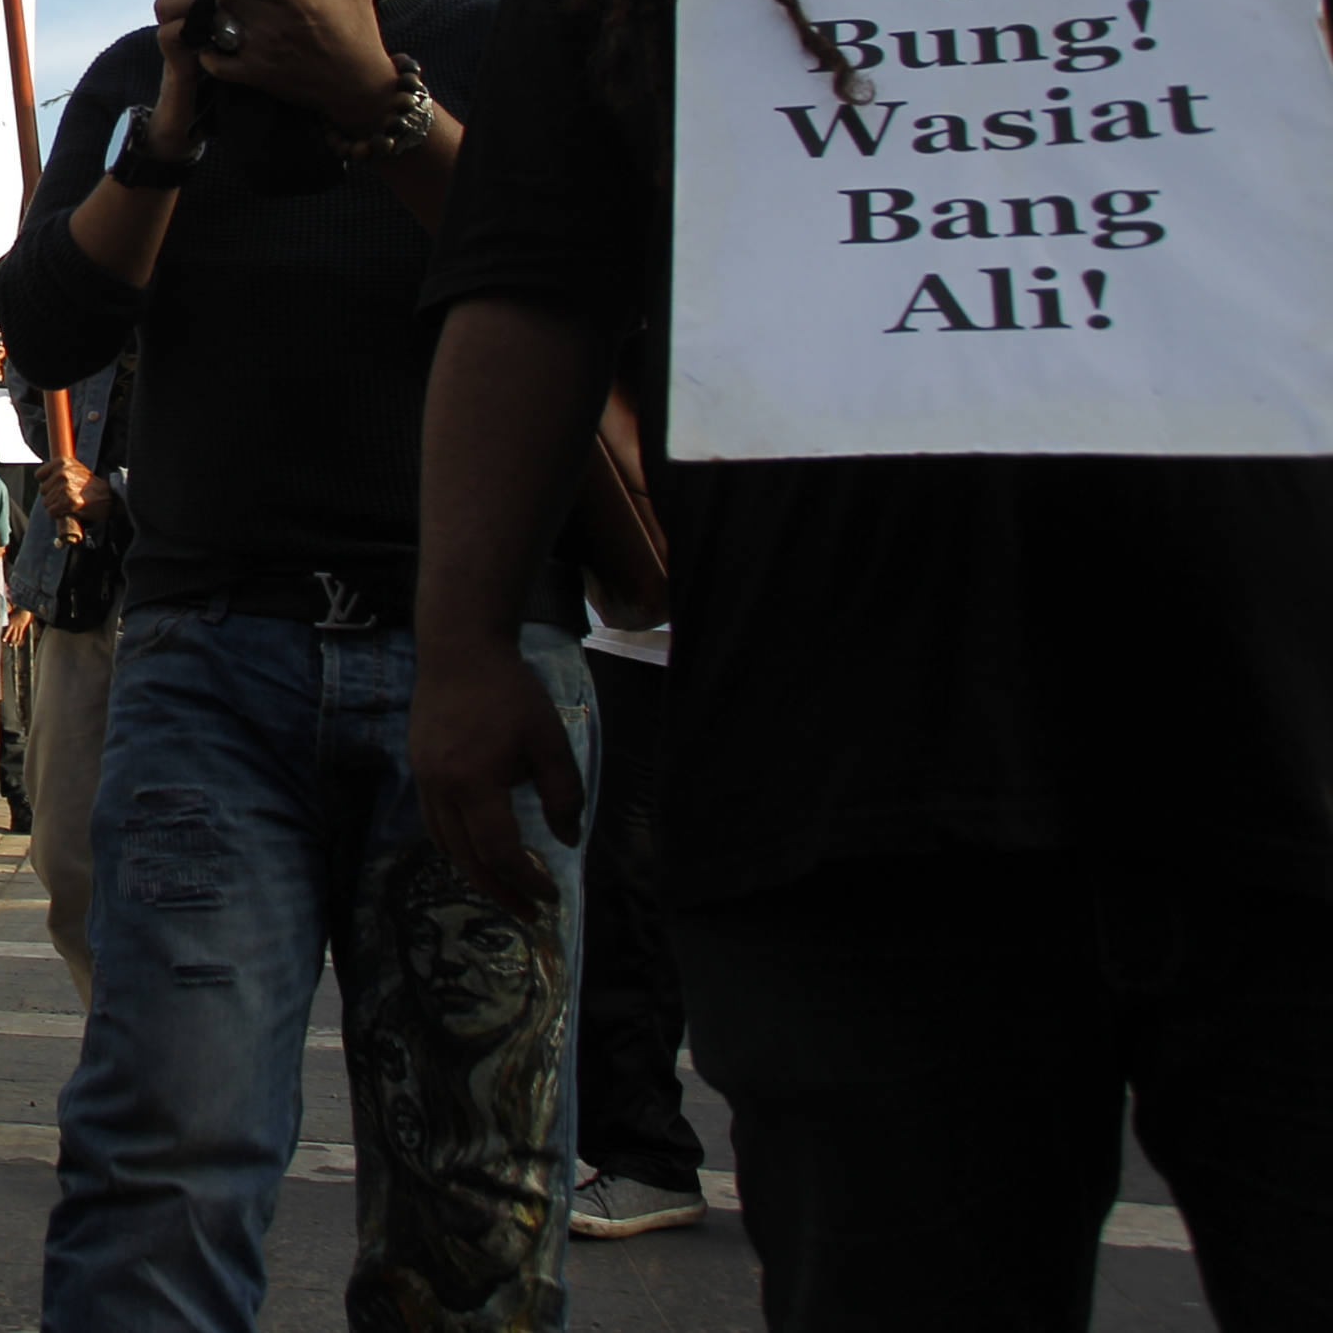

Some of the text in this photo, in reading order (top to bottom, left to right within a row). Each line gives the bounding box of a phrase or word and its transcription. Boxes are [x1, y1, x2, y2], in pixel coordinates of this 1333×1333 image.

[774, 84, 1215, 159] Wasiat
[838, 188, 1167, 250] Bang
[883, 266, 1114, 334] Ali!
